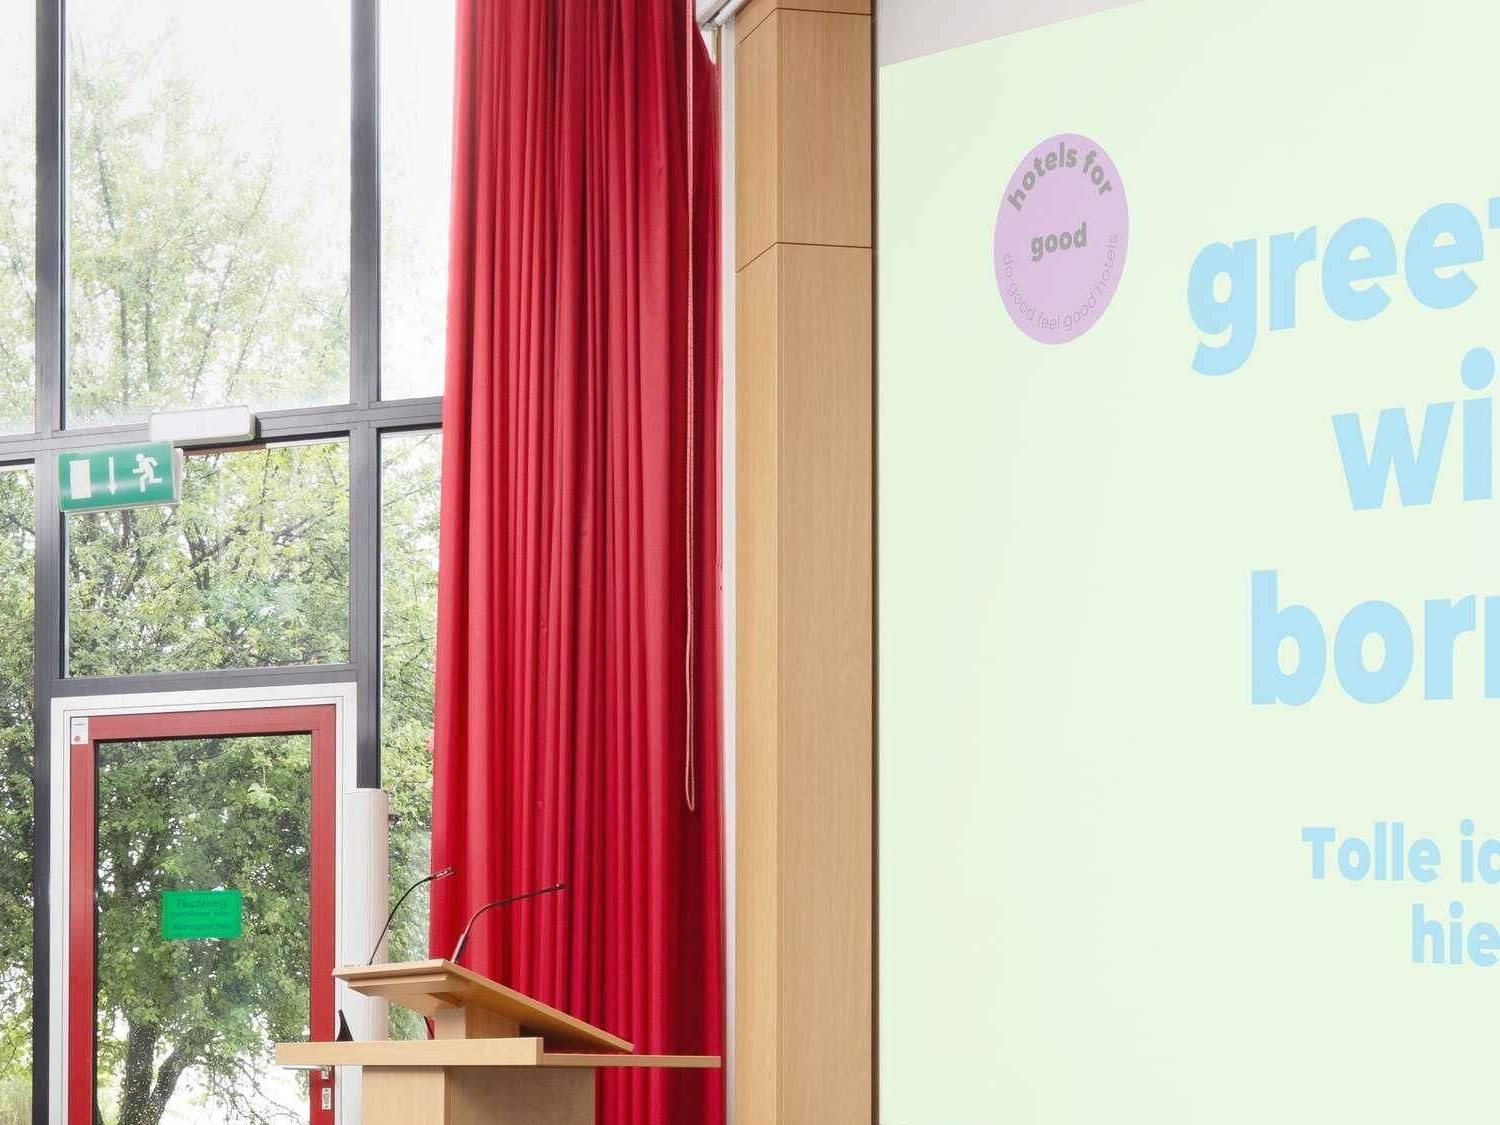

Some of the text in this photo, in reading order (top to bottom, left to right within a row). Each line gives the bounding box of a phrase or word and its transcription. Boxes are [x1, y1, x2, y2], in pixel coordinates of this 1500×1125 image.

[1007, 141, 1114, 212] hotels for
[1030, 221, 1088, 262] good
[1006, 282, 1037, 321] good
[1037, 311, 1061, 331] feel
[1063, 292, 1098, 332] good
[1187, 196, 1500, 377] gree
[1251, 568, 1500, 707] bor
[1300, 820, 1442, 884] Tolle
